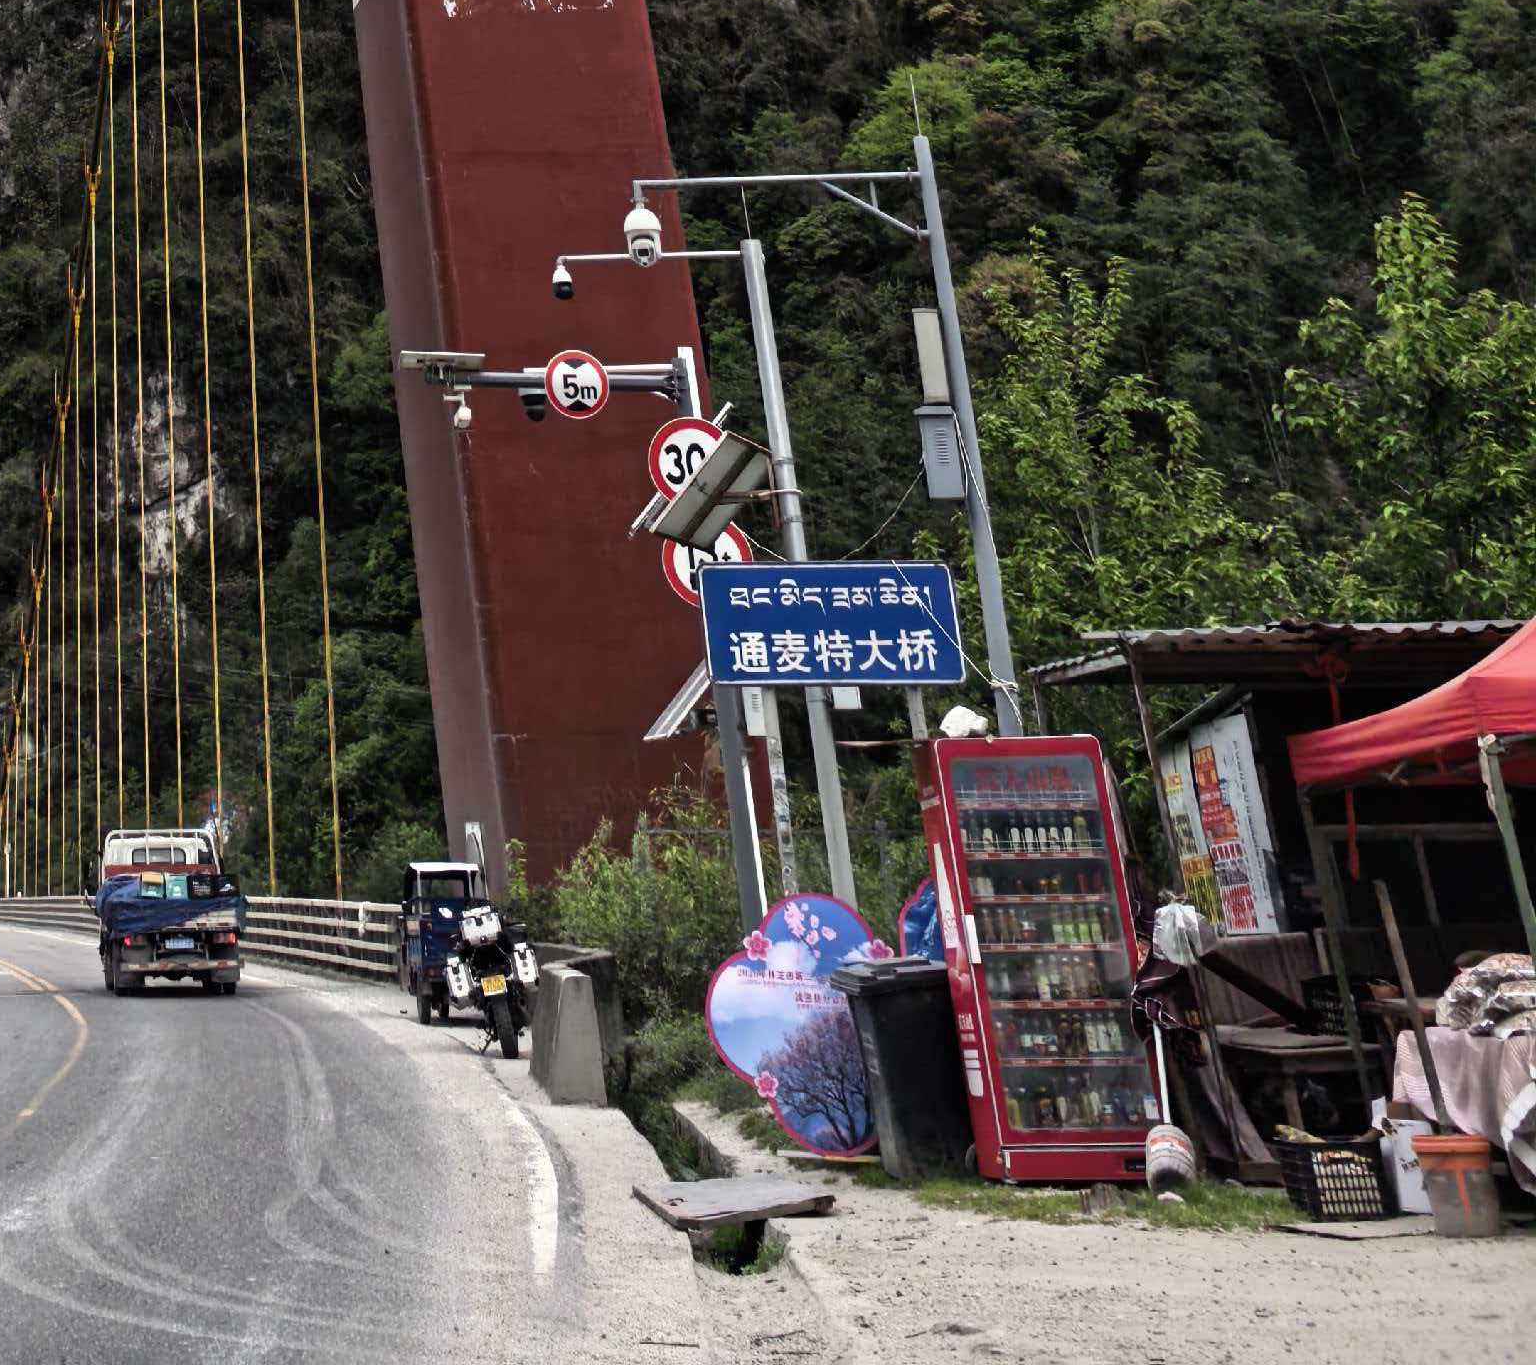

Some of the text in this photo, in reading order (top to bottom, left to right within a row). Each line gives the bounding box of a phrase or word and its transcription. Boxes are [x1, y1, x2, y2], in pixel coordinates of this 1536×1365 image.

[562, 374, 598, 401] 5m
[729, 629, 938, 673] 通麦特大桥
